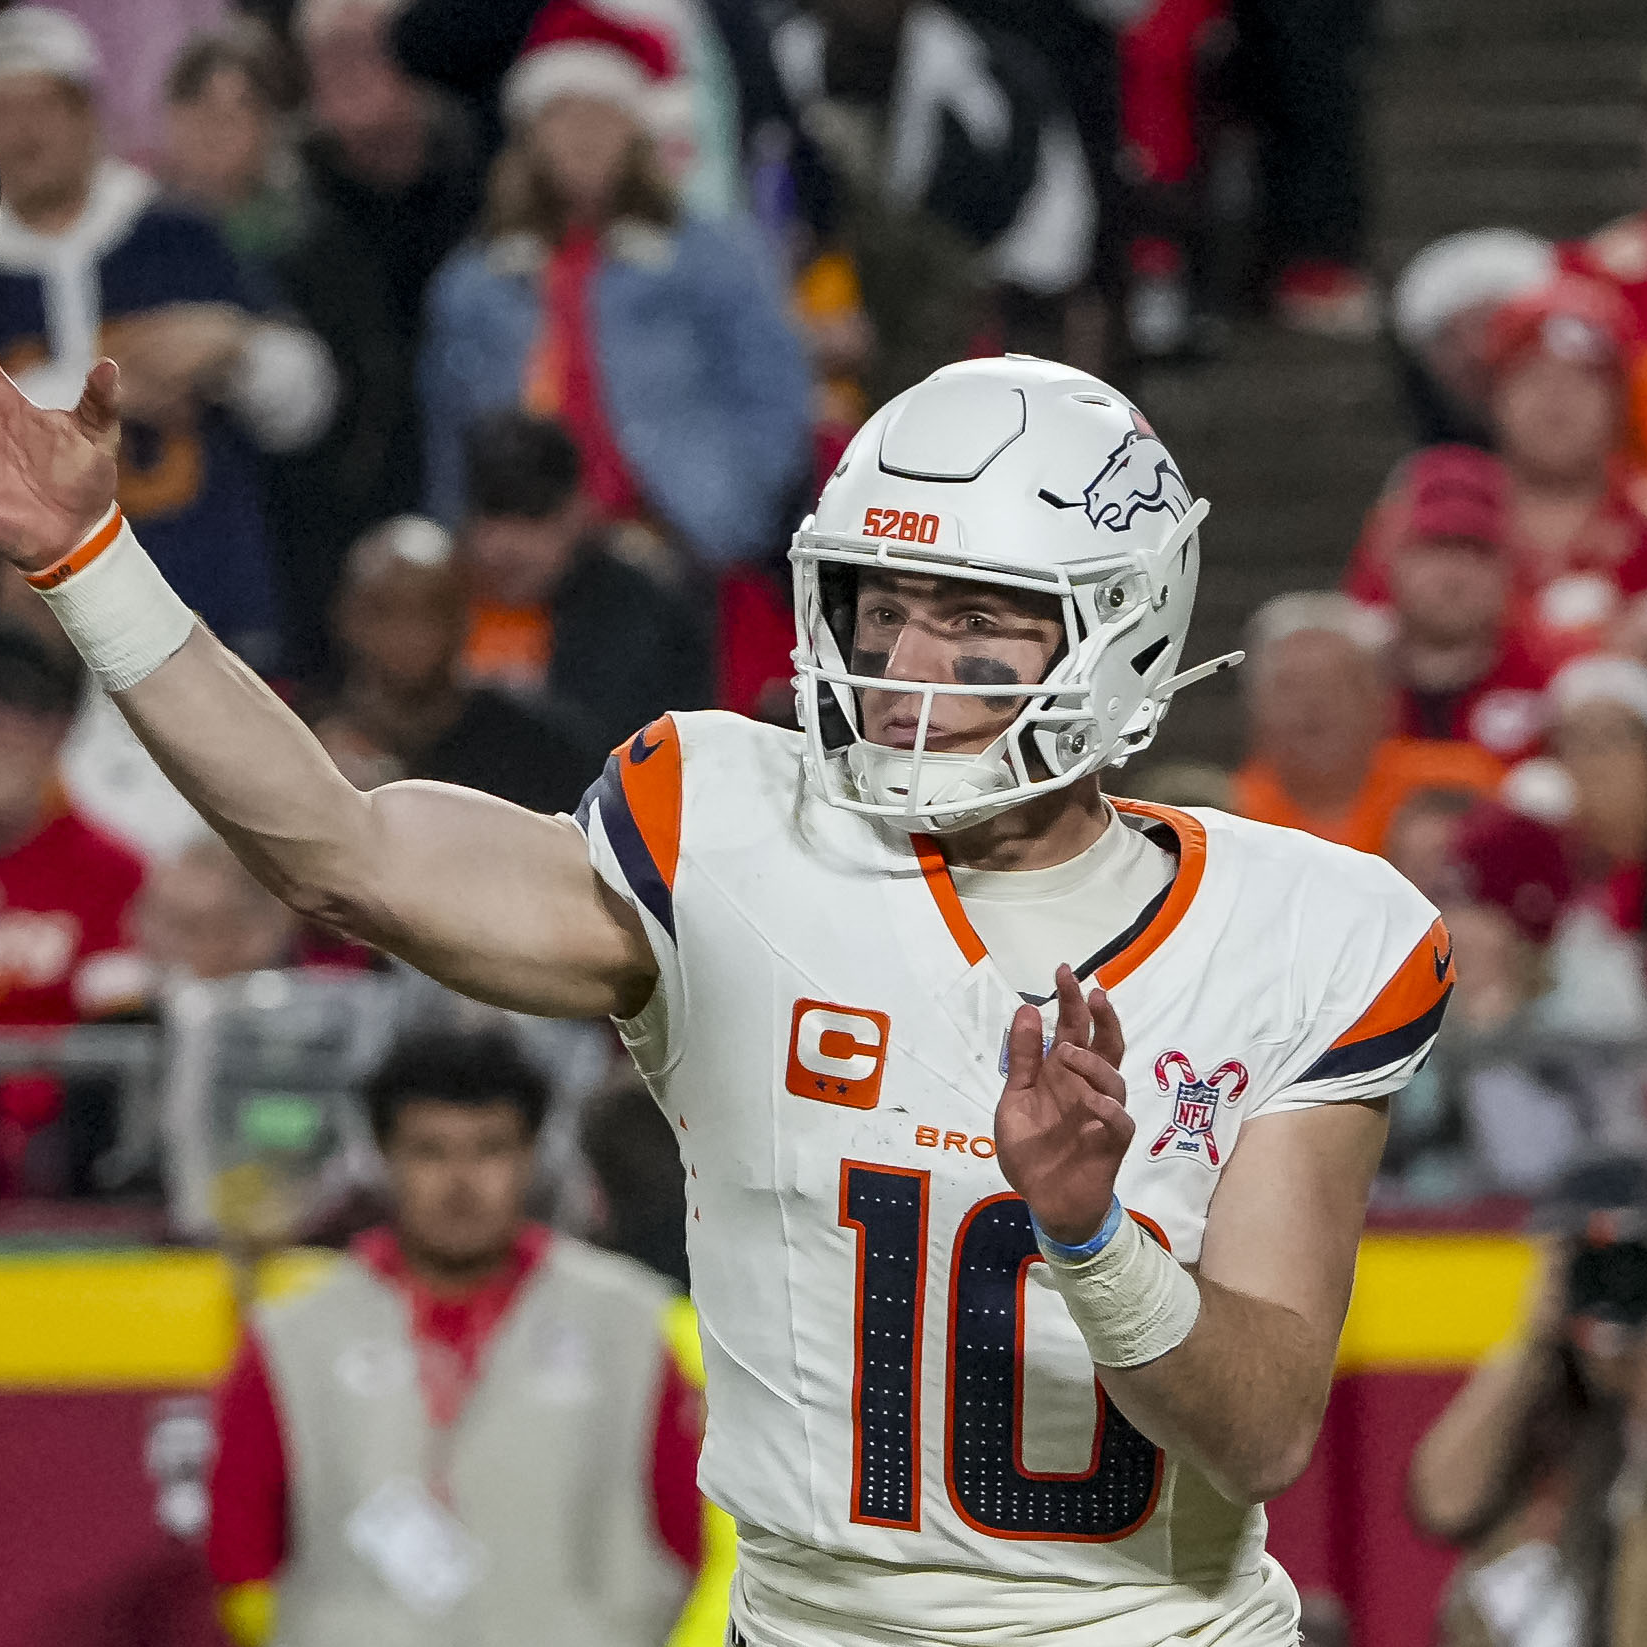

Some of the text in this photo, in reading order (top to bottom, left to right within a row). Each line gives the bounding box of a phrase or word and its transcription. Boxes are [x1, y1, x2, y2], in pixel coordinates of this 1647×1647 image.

[861, 506, 941, 545] 5280
[796, 1007, 882, 1082] C
[1176, 1101, 1211, 1130] NFL
[1175, 1140, 1201, 1153] 2025
[838, 1158, 1172, 1544] 10
